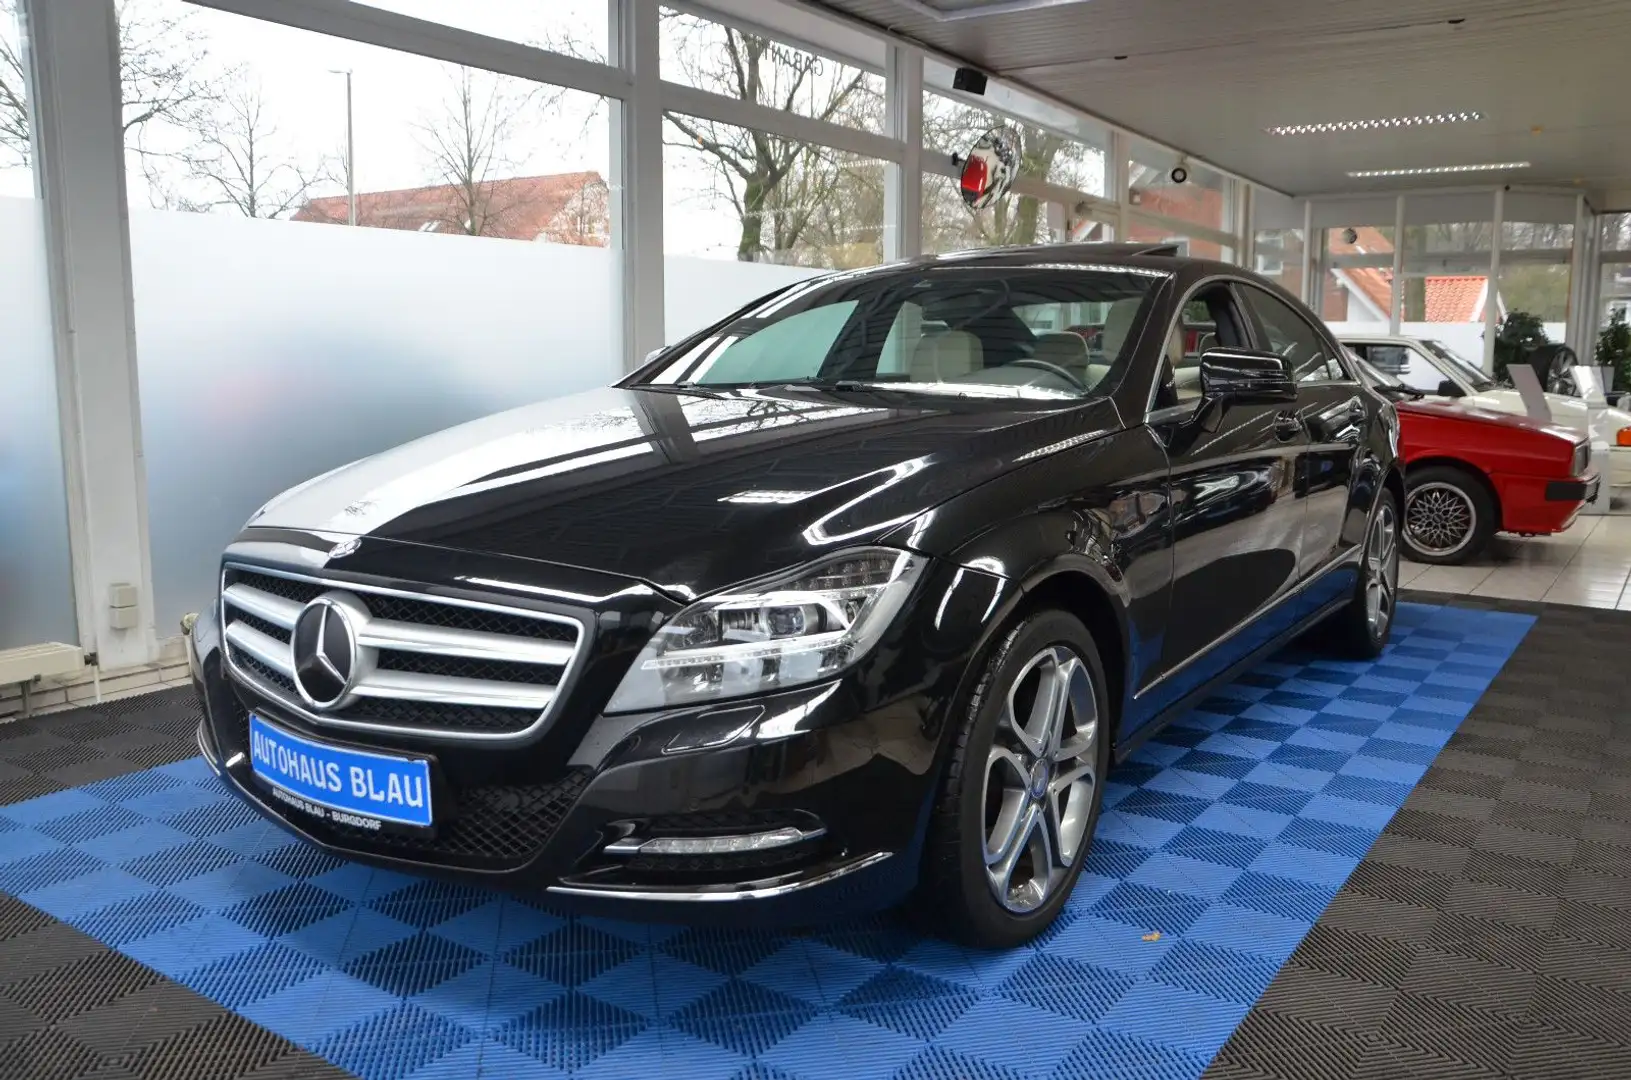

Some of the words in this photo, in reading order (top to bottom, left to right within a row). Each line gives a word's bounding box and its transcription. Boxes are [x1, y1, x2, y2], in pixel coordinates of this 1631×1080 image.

[254, 731, 342, 792] AUTOHAUS
[350, 767, 423, 808] BLAU
[272, 787, 305, 810] AUTOHAUS
[305, 802, 325, 817] BLAU
[332, 811, 382, 830] BURGDORF
